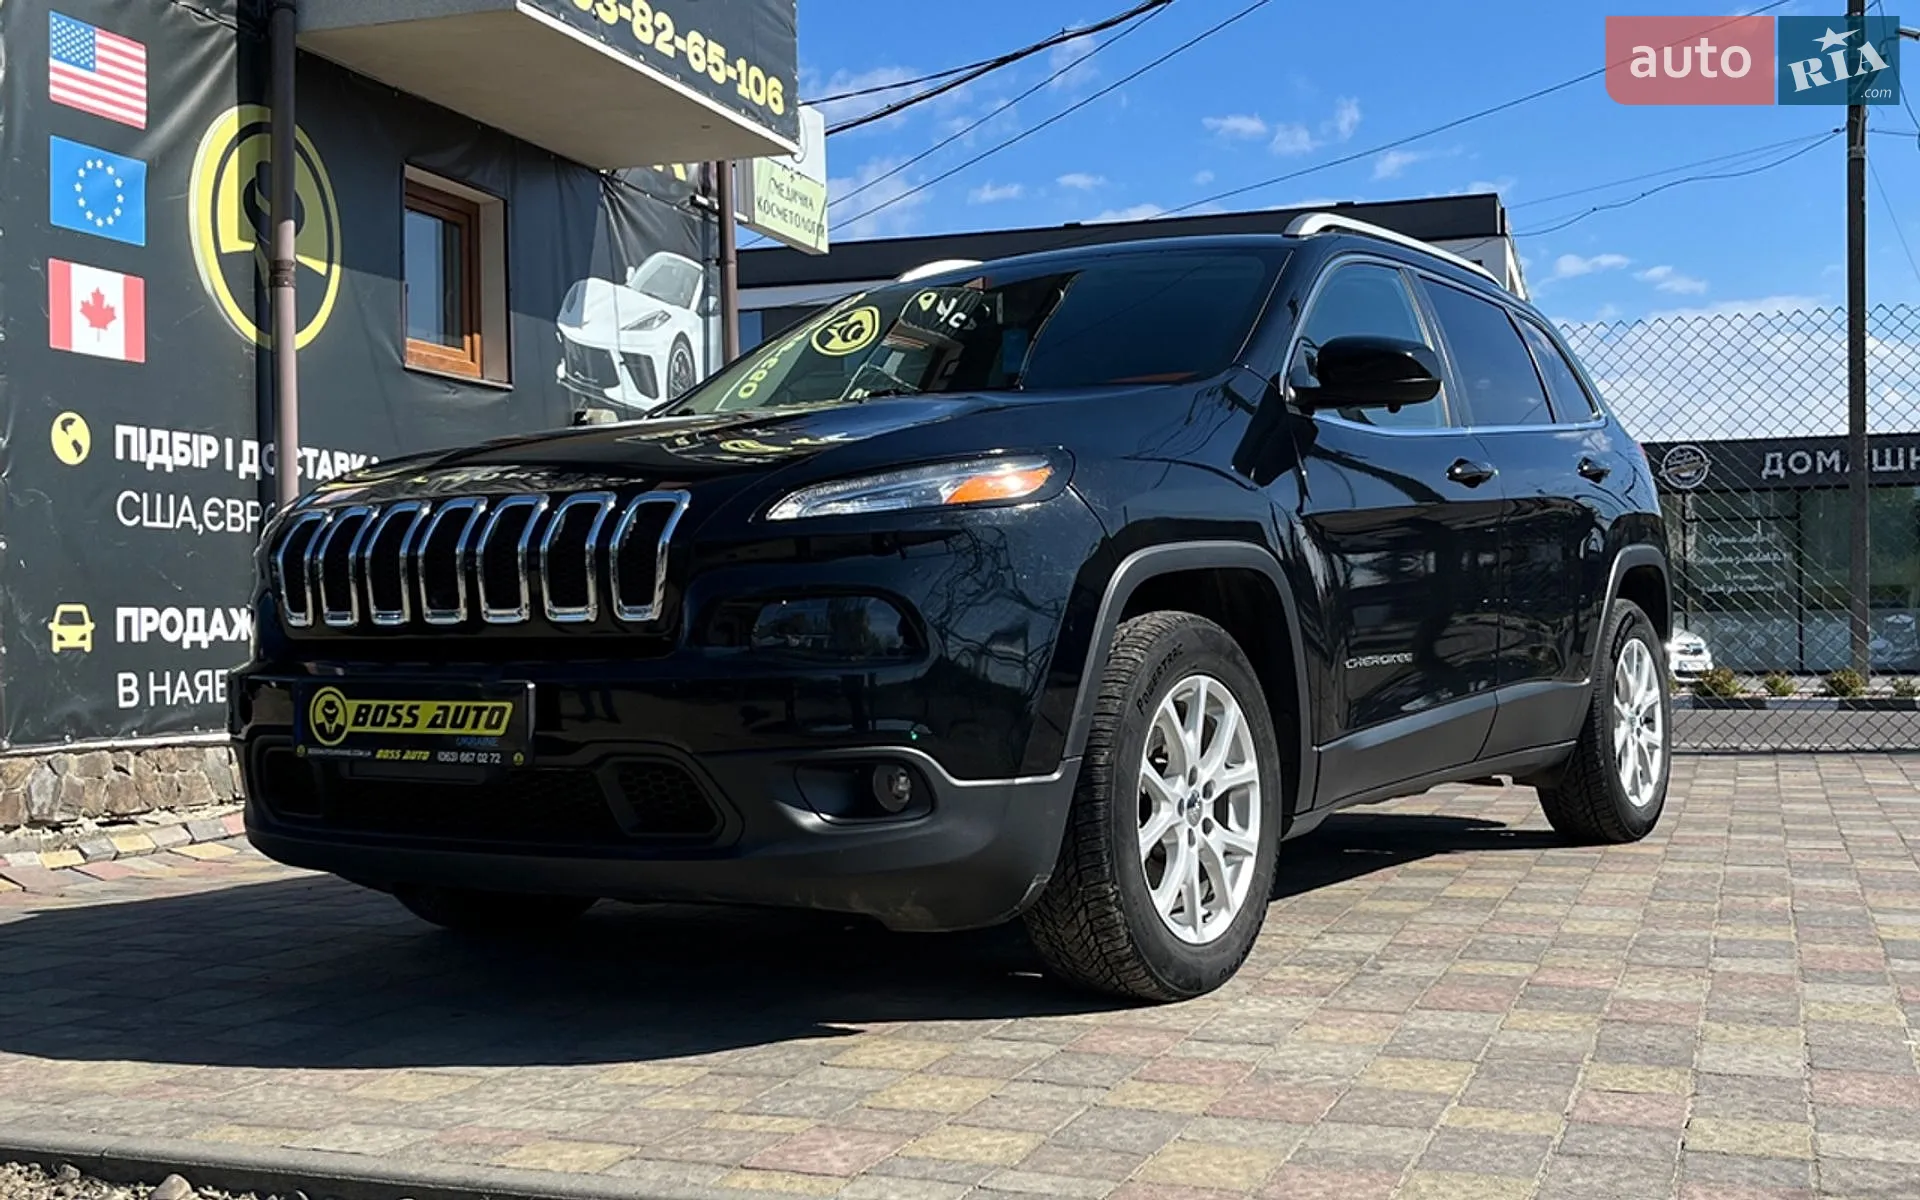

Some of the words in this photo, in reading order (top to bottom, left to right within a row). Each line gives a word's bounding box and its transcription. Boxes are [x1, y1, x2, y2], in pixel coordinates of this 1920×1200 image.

[573, 0, 785, 115] 3-82-65-106
[115, 424, 220, 472] ПІДБІР
[116, 606, 252, 649] ПРОДАЖ
[1344, 652, 1413, 669] CHEROKEE
[117, 672, 140, 708] В
[351, 704, 420, 727] BOSS
[426, 705, 508, 730] AUTO
